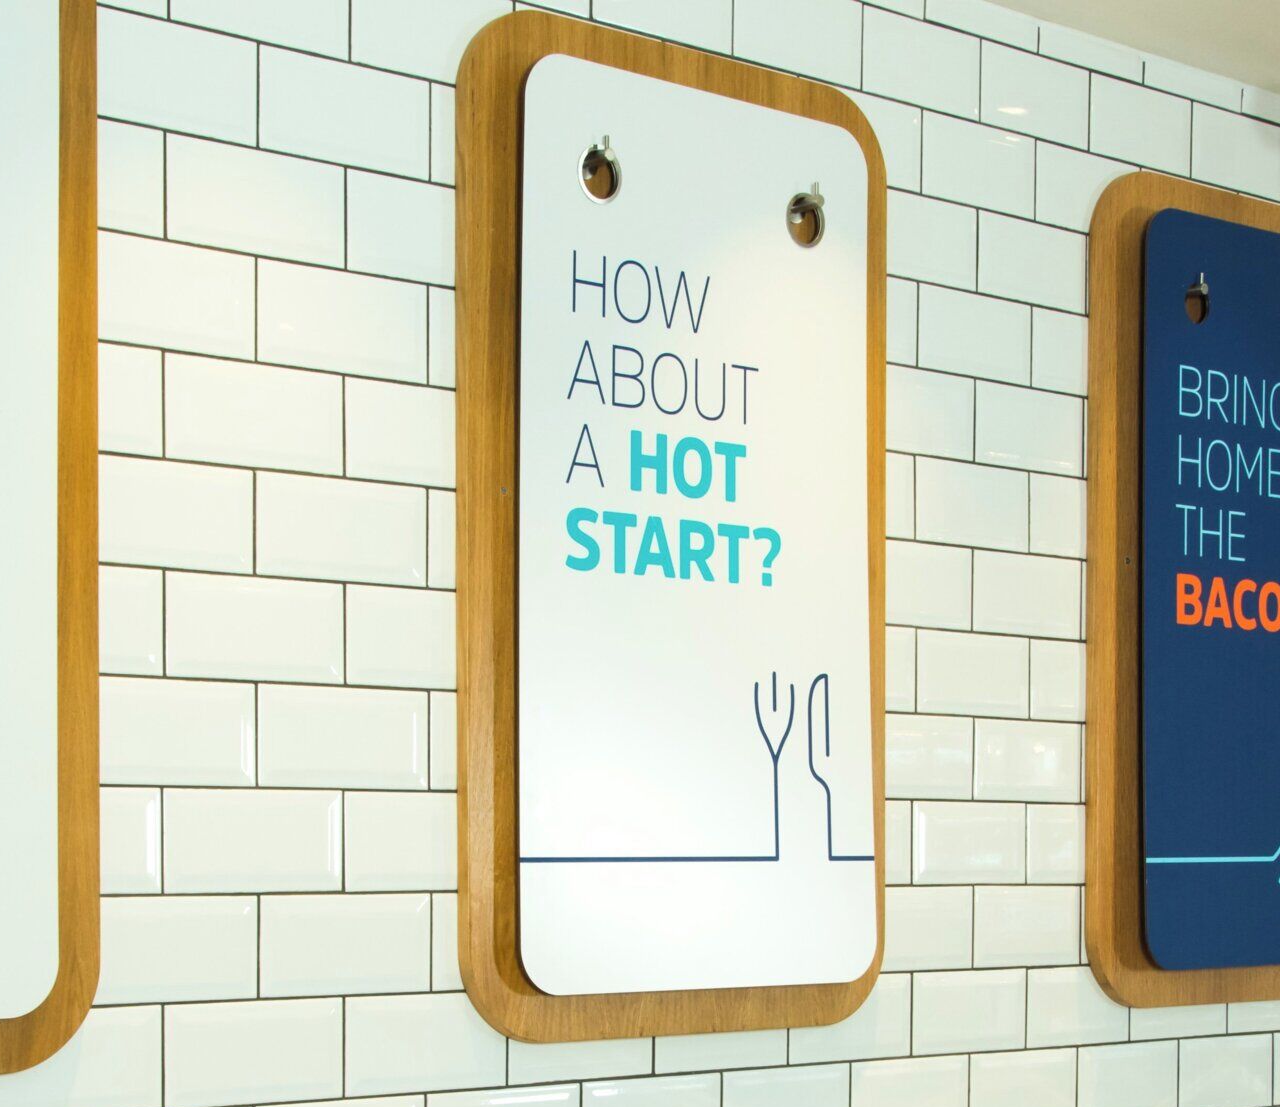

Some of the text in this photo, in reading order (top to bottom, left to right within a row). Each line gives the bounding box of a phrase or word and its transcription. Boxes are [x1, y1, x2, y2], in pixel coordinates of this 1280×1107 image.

[572, 250, 710, 333] HOW
[567, 340, 759, 425] ABOUT
[565, 424, 746, 502] A HOT
[565, 507, 781, 587] START?
[1175, 503, 1245, 562] THE
